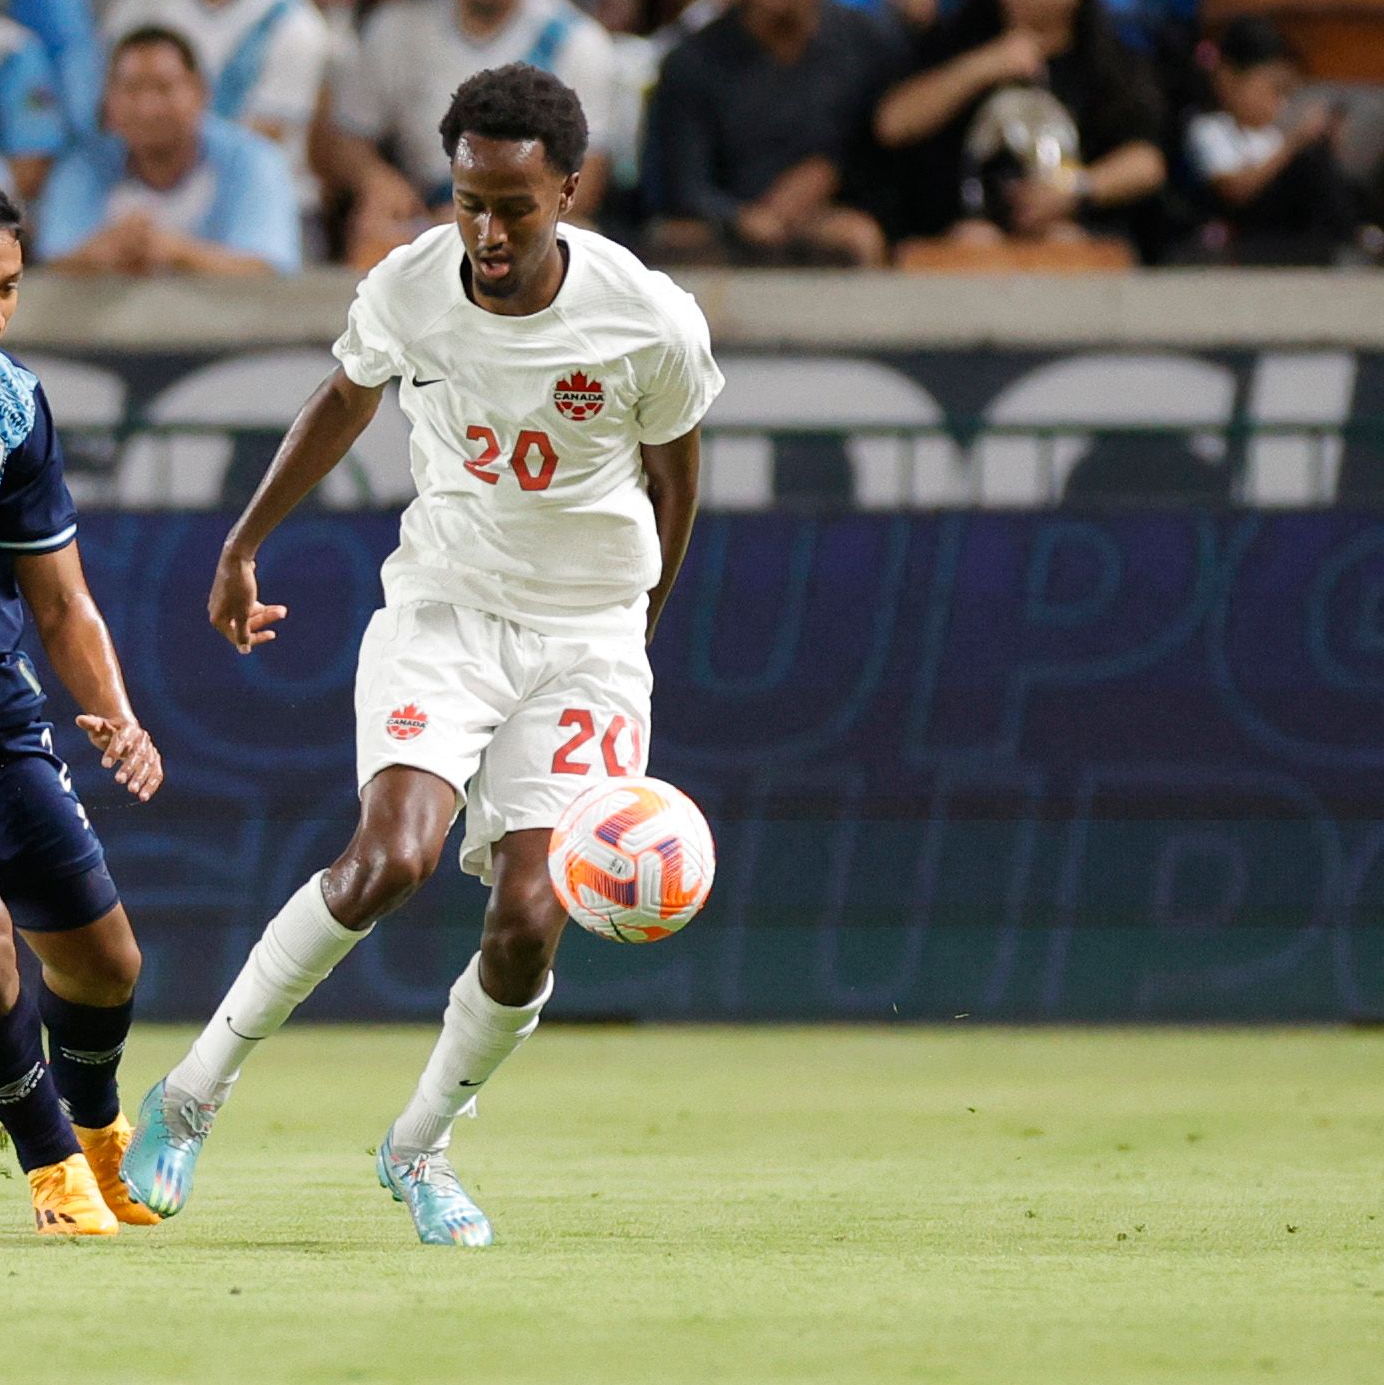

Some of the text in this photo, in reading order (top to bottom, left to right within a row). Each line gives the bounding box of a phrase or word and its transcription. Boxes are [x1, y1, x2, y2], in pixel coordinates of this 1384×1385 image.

[553, 392, 605, 402] CANADA
[463, 424, 559, 492] 20
[386, 718, 428, 729] CANADA
[551, 707, 642, 777] 20
